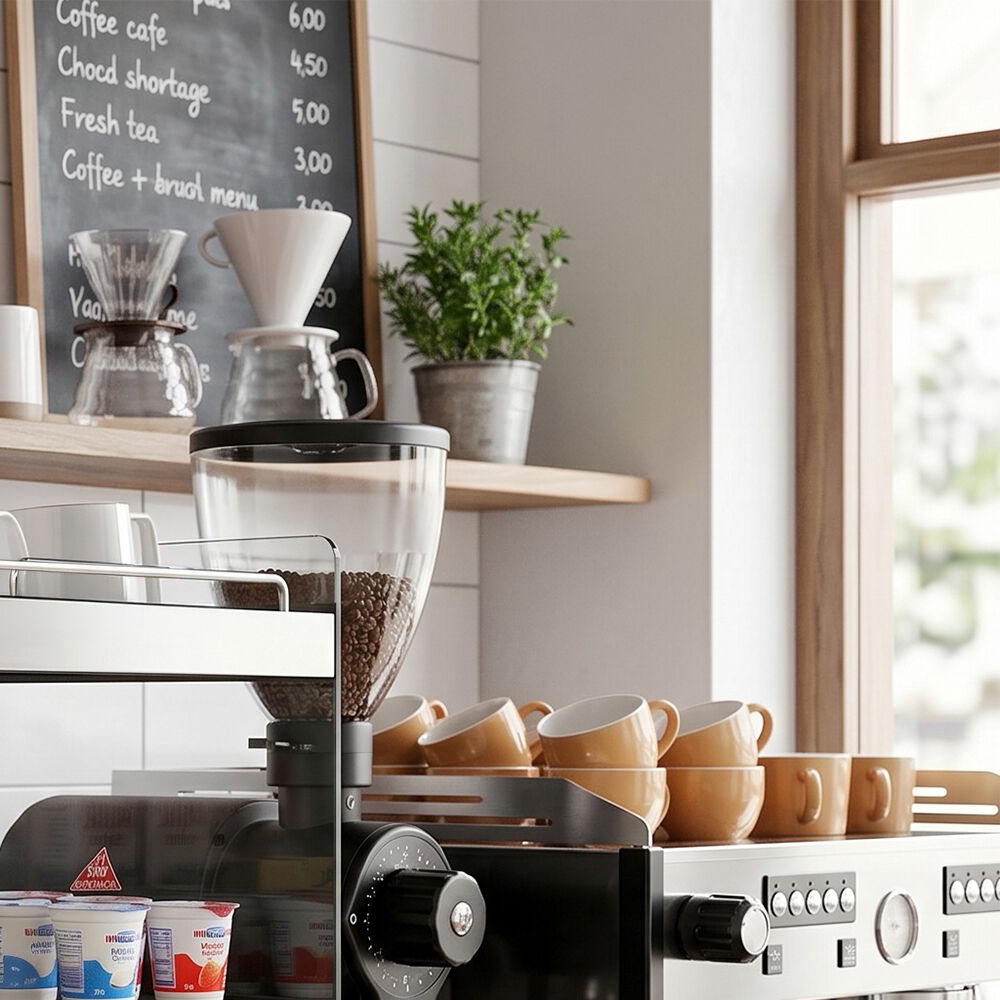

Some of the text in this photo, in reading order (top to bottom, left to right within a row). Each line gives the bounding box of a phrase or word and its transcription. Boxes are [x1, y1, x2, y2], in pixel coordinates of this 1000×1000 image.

[56, 0, 169, 51] Coffee cafe
[288, 2, 326, 32] 6,00
[289, 49, 328, 78] 4,50
[124, 58, 212, 118] shortage
[61, 97, 160, 144] Fresh tea
[62, 148, 125, 191] Coffee
[210, 185, 260, 212] menu
[294, 146, 333, 176] 3,00
